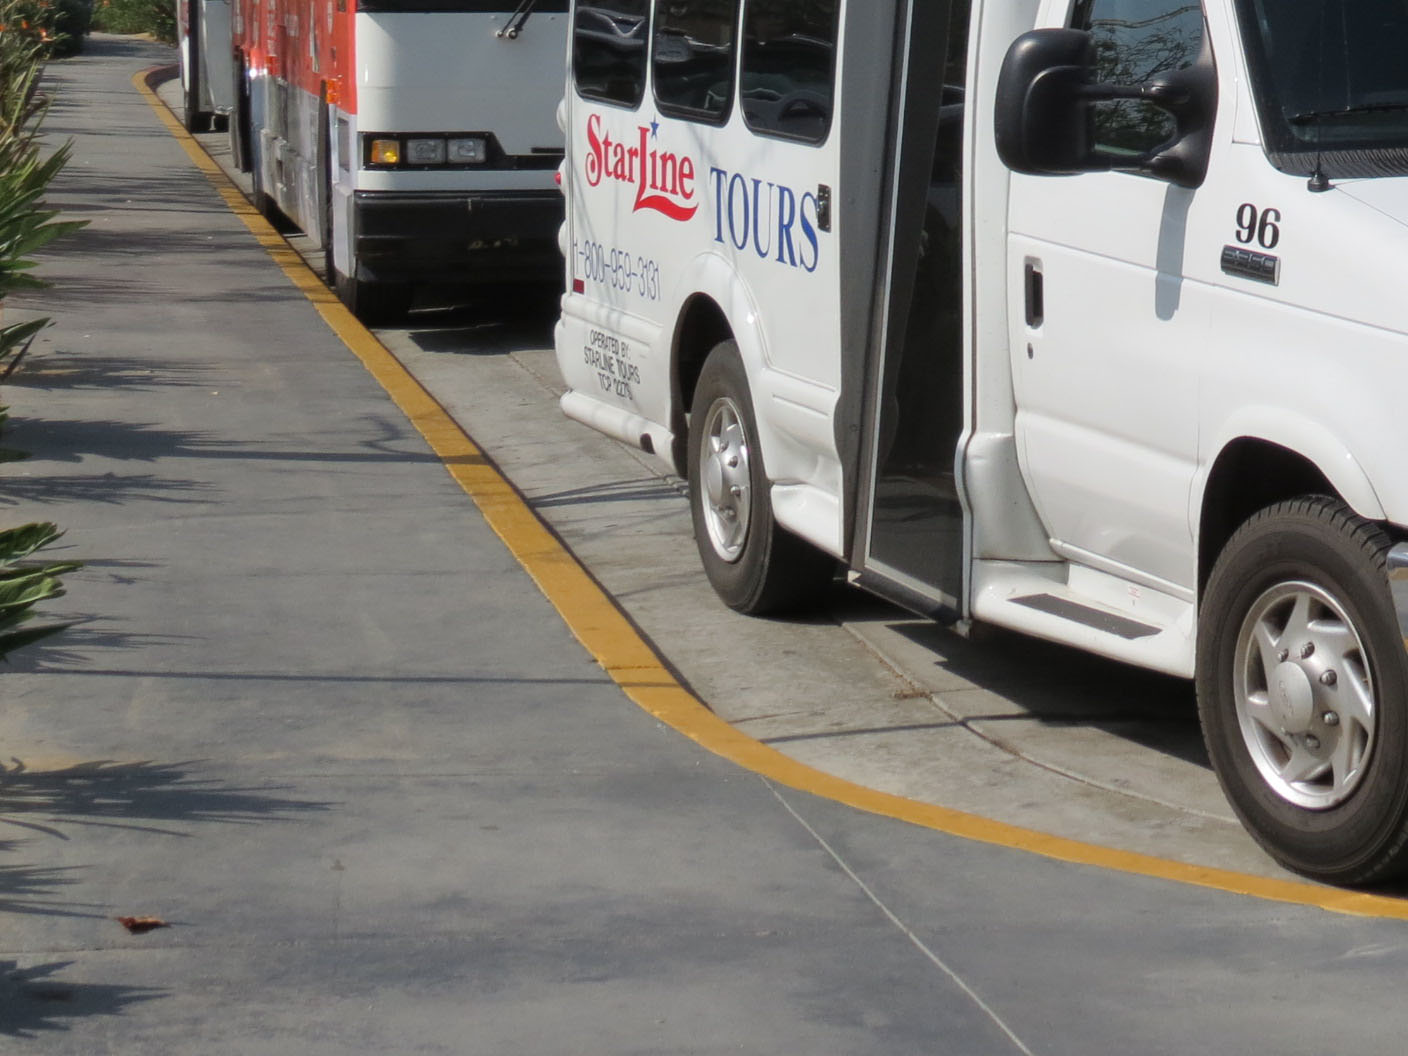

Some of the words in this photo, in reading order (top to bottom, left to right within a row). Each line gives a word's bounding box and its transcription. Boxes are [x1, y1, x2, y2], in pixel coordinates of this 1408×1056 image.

[585, 113, 699, 222] StarLine
[710, 166, 819, 273] TOURS
[1235, 202, 1281, 250] 96
[573, 238, 661, 302] 1-800-959-3131
[584, 346, 615, 375] STARLINE
[616, 358, 641, 384] TOURS
[590, 329, 620, 355] OPERATED
